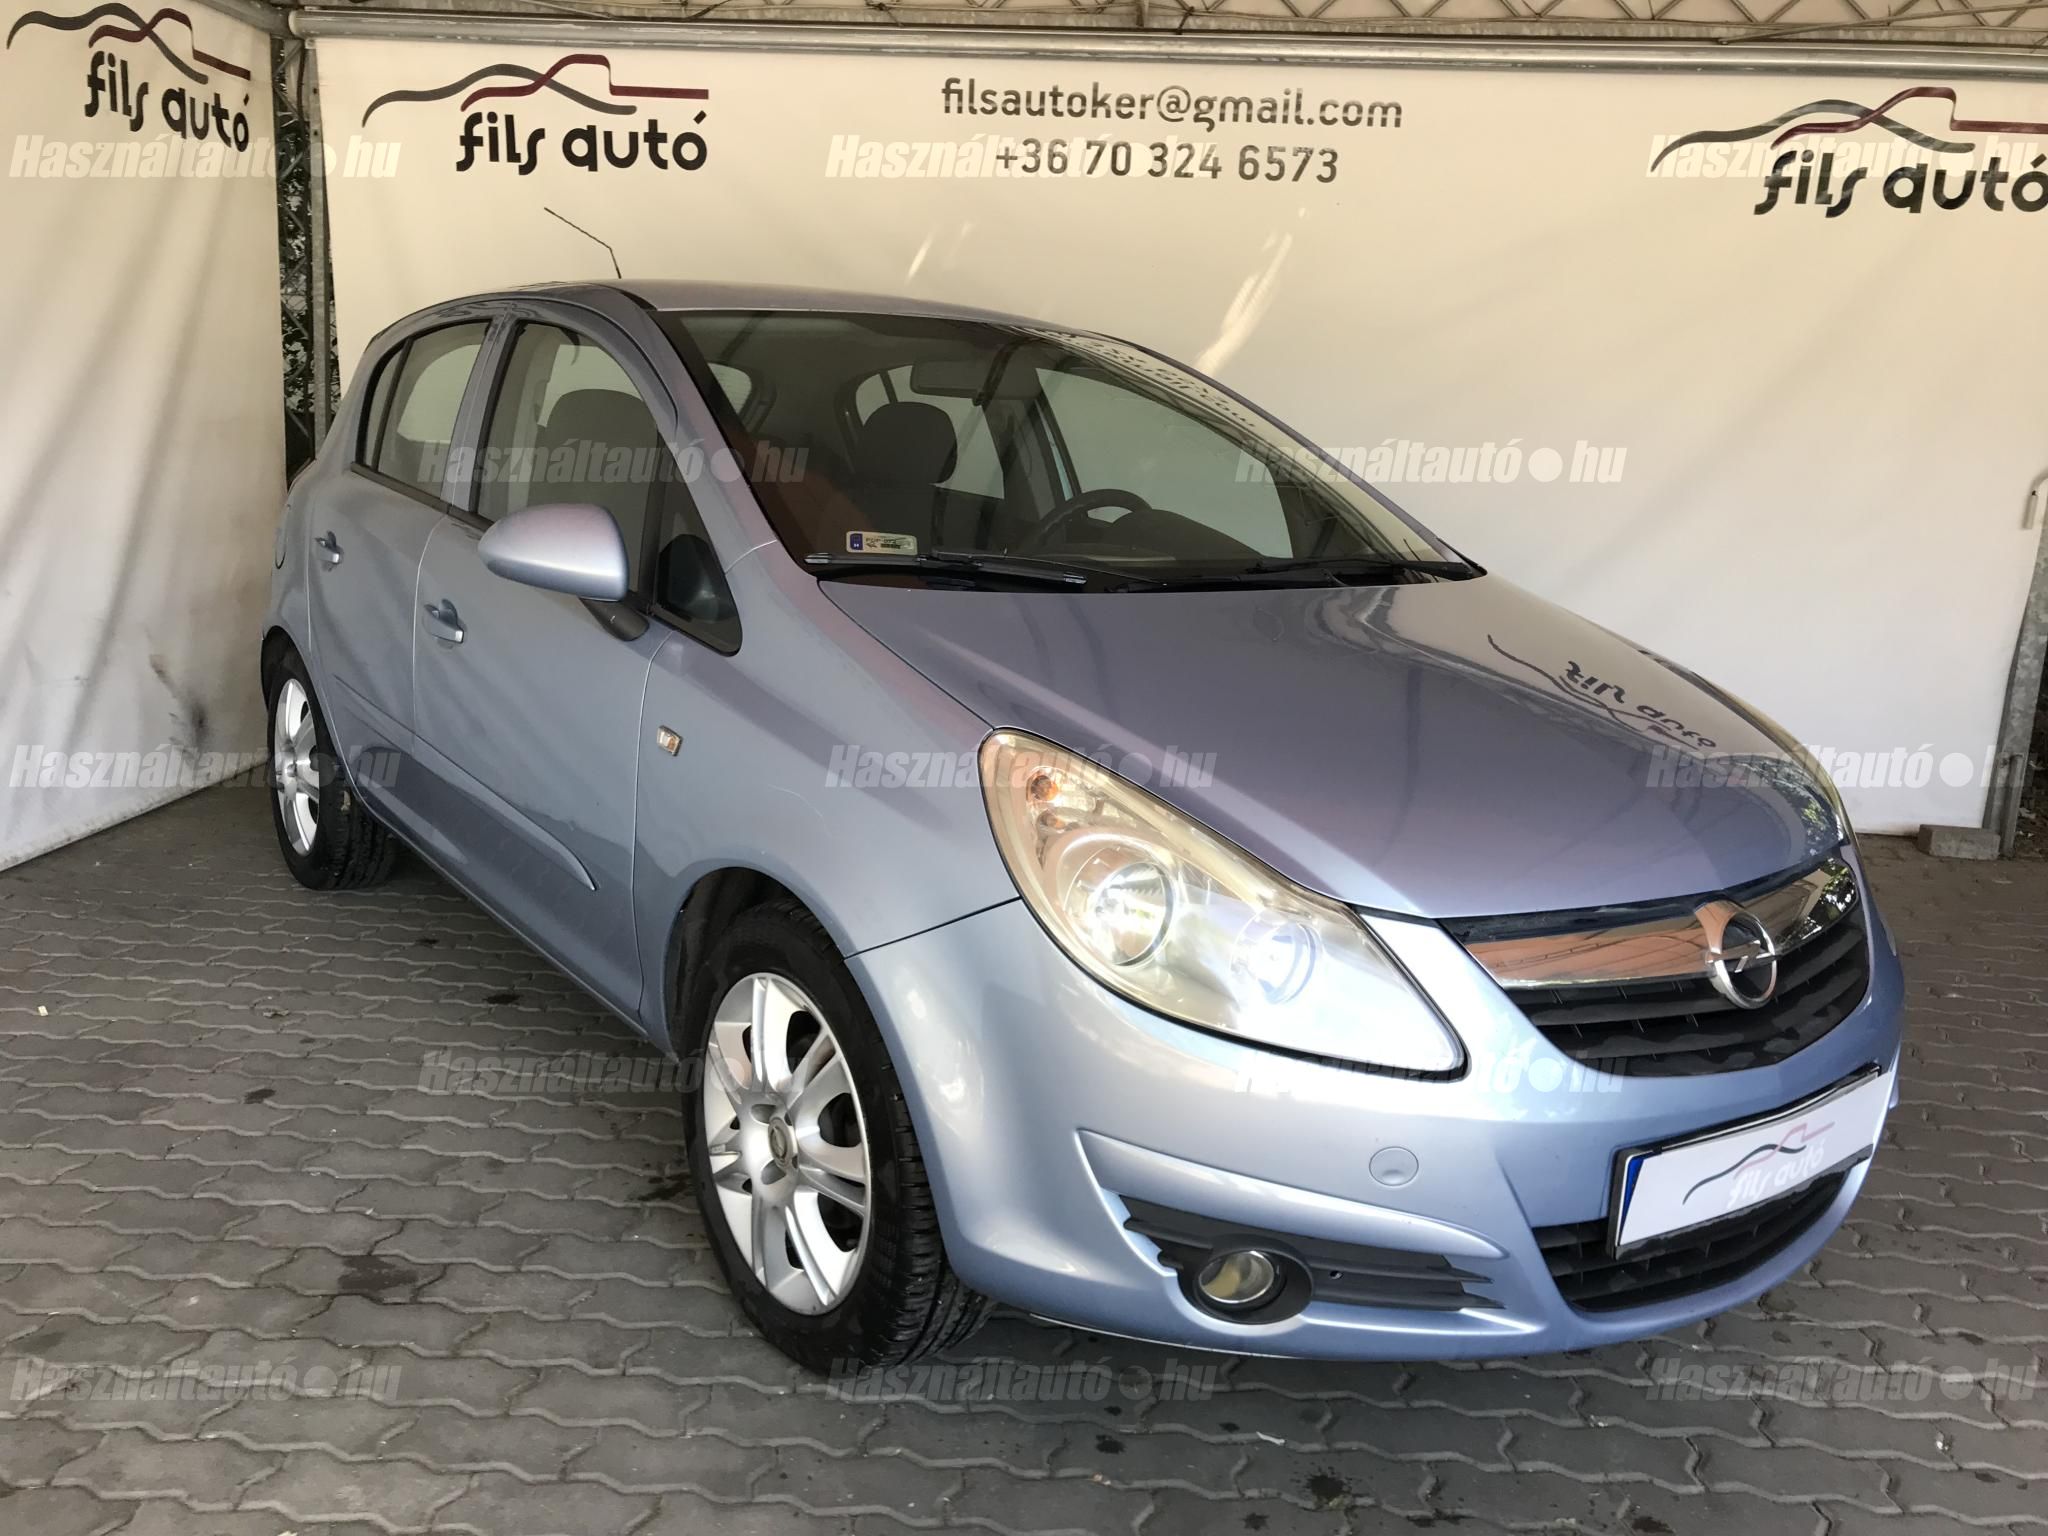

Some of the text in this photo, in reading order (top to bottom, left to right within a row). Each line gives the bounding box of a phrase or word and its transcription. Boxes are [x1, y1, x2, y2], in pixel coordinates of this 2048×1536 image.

[85, 51, 250, 152] fils autó
[942, 77, 1403, 133] filsautoker@gmail.com
[456, 111, 709, 175] fils autó
[996, 138, 1338, 183] +36 70 324 6573
[1754, 150, 2048, 218] fils autó
